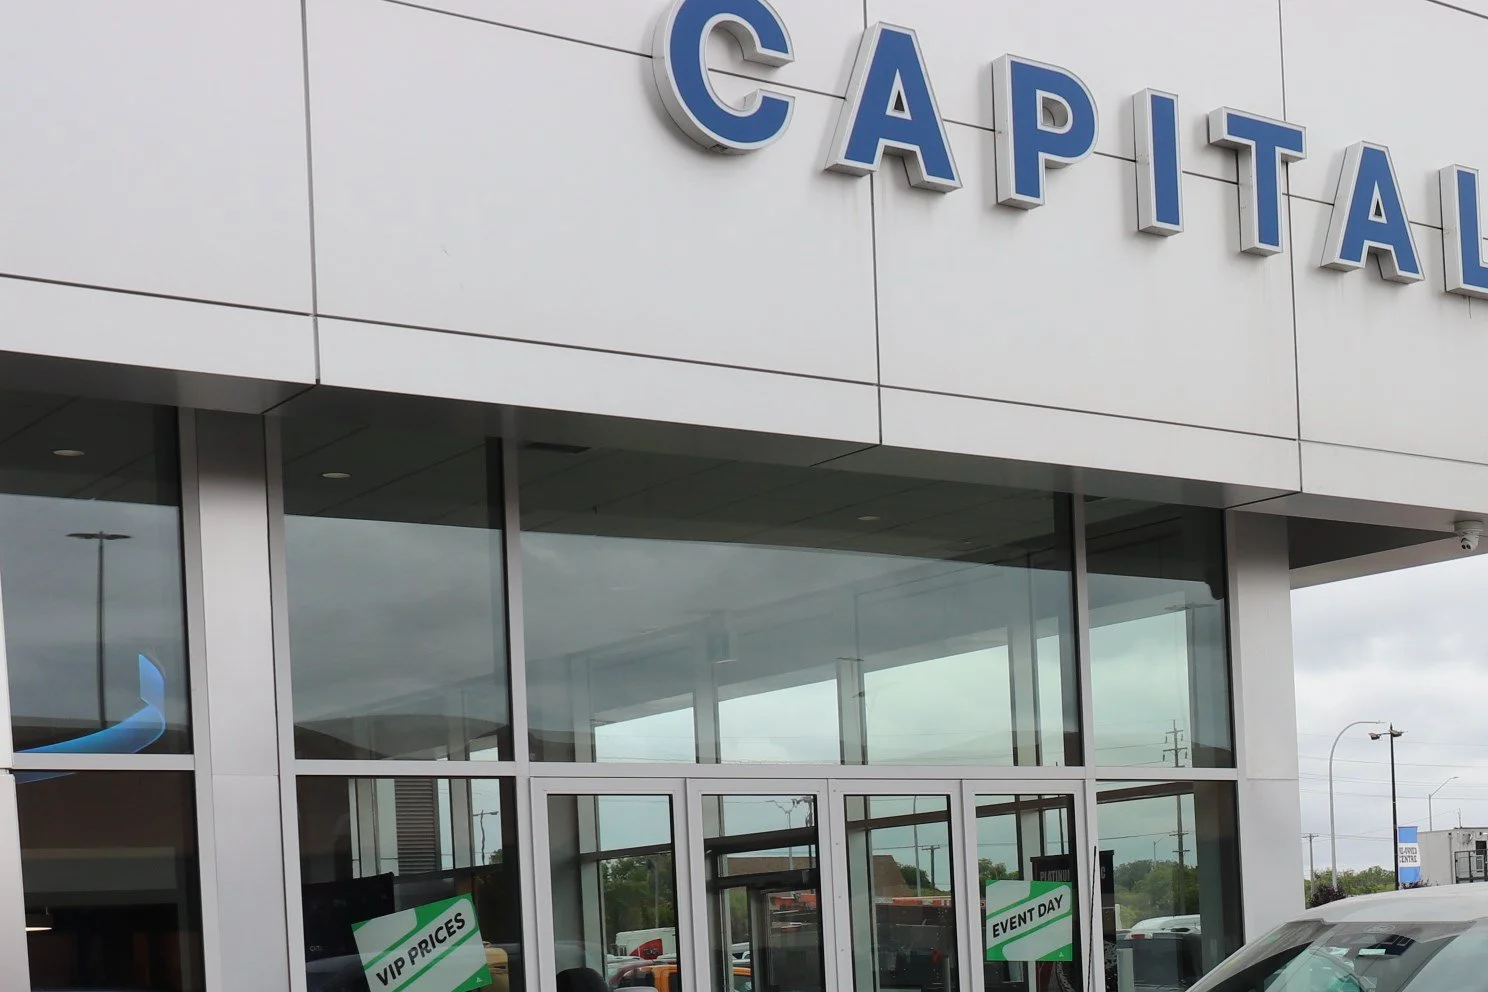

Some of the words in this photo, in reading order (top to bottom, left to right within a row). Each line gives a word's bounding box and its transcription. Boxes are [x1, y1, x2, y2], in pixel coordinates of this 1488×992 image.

[1040, 868, 1070, 882] PLATINU
[992, 907, 1035, 938] EVENT
[1037, 894, 1063, 918] DAY
[375, 956, 406, 986] VIP
[407, 912, 466, 966] PRICES
